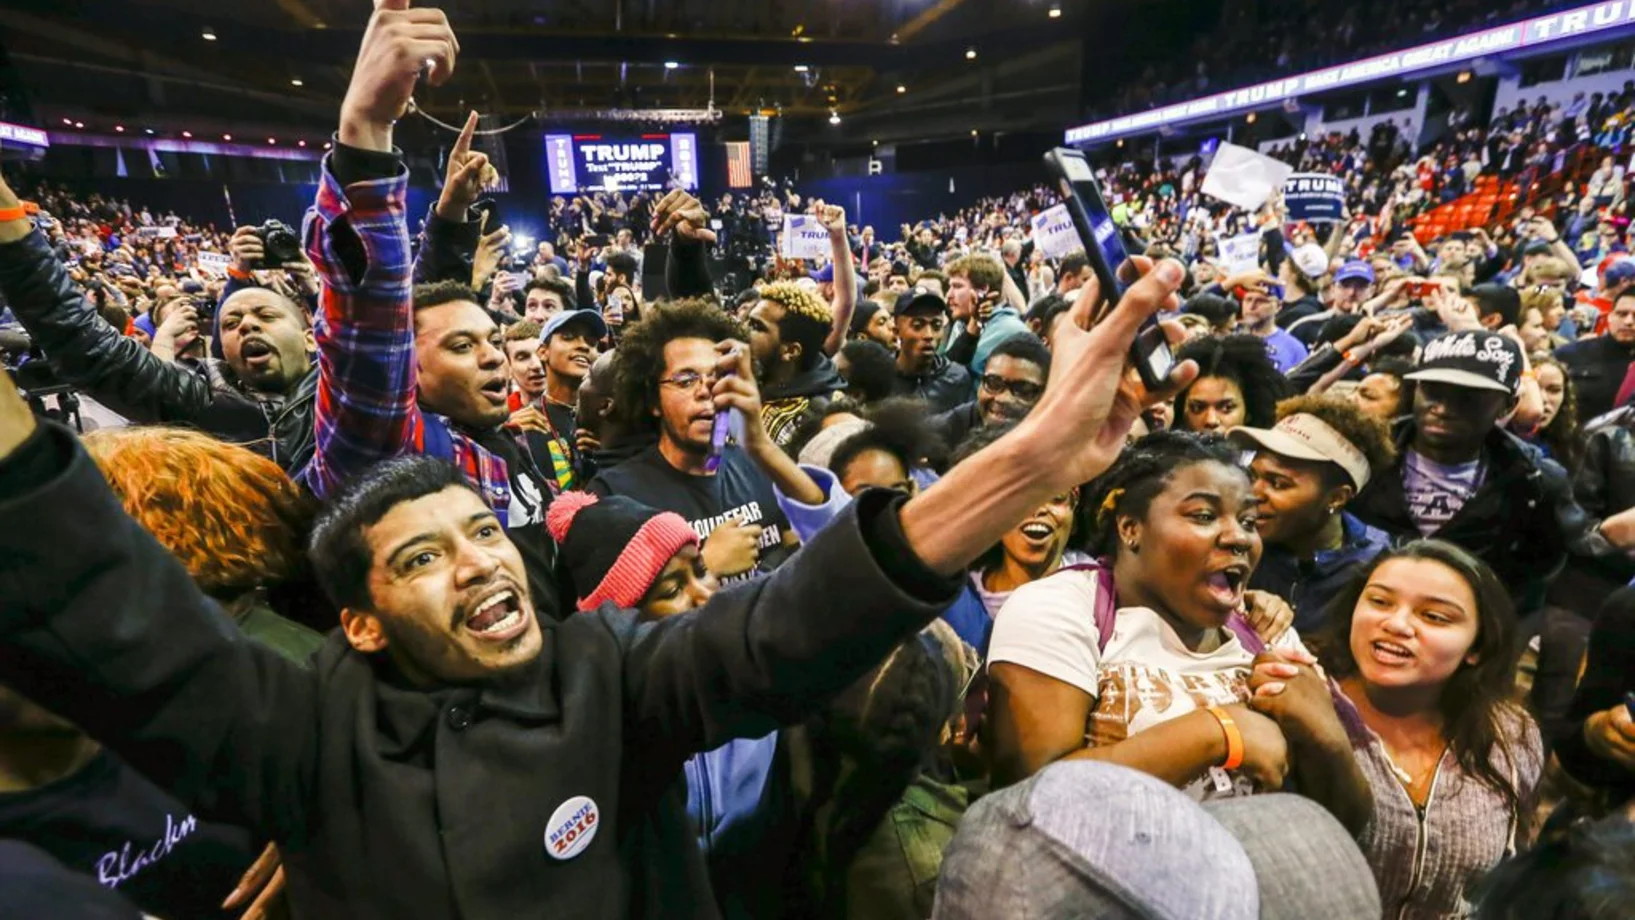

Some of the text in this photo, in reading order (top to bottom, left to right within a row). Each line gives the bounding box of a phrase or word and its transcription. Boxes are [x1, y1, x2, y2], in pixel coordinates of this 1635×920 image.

[1534, 1, 1635, 38] TRU
[1225, 79, 1298, 107] TRUMP
[1341, 56, 1400, 81] AMERICA
[1402, 43, 1453, 68] GREAT
[1454, 28, 1516, 56] AGAIN!
[555, 138, 571, 188] TRUMP
[580, 144, 665, 161] TRUMP
[586, 163, 608, 172] Text
[550, 803, 592, 844] BERNIE
[554, 813, 596, 853] 2016
